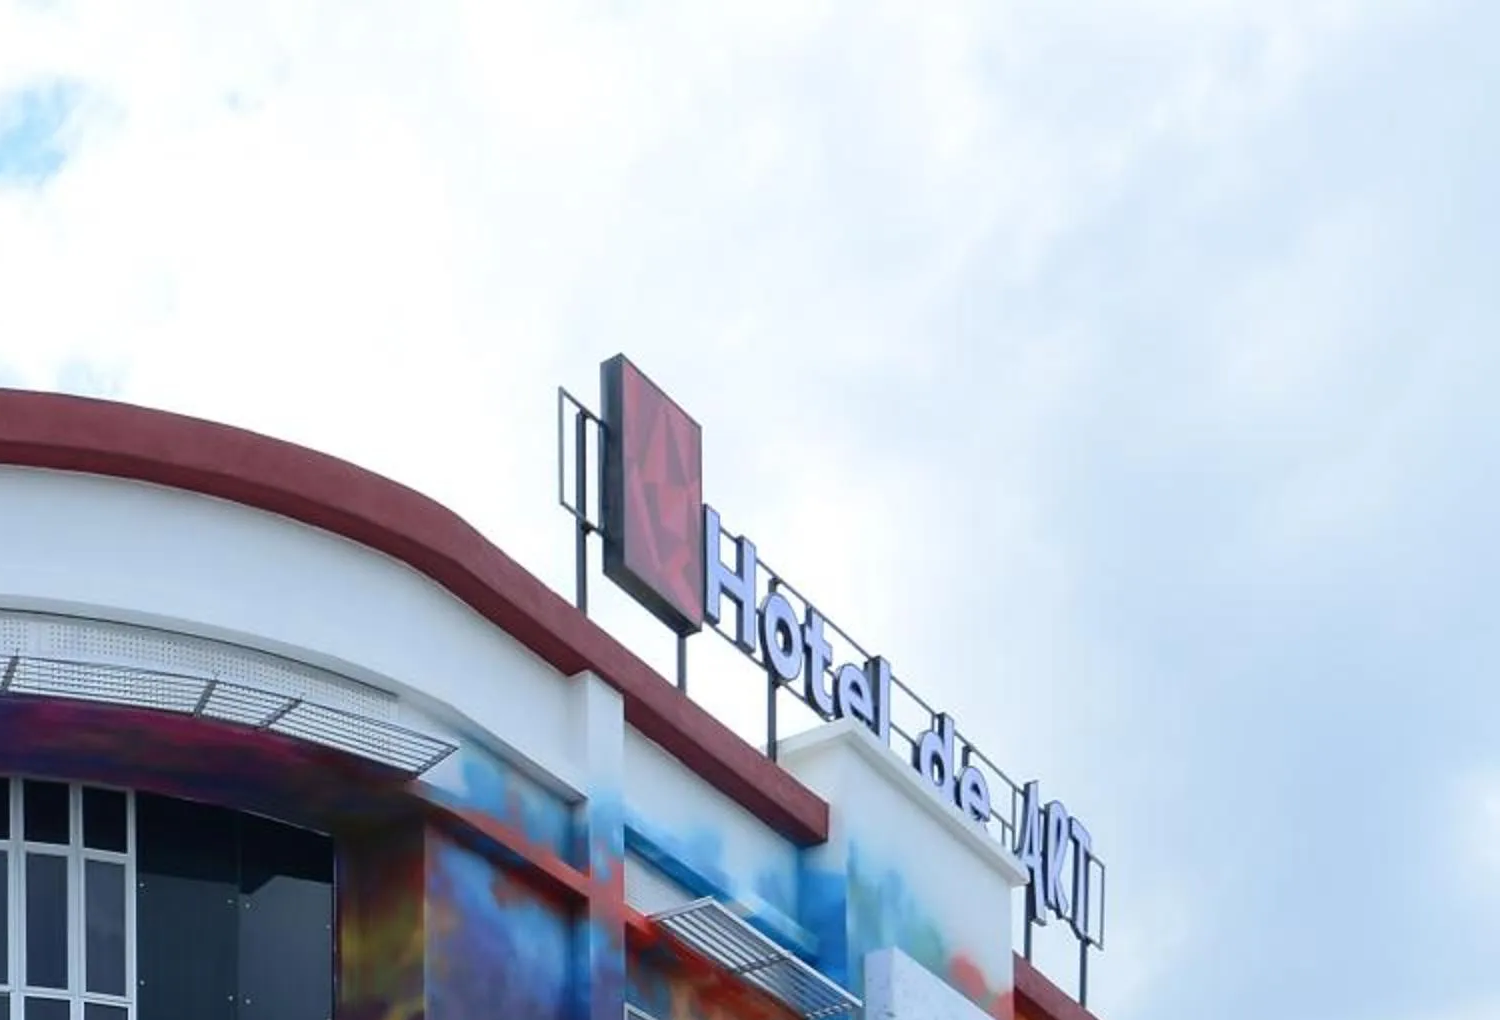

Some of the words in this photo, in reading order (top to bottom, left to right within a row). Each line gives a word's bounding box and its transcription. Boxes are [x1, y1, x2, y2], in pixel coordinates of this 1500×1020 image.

[703, 503, 891, 748] Hotel
[912, 712, 991, 823] de
[1015, 780, 1092, 939] ART
